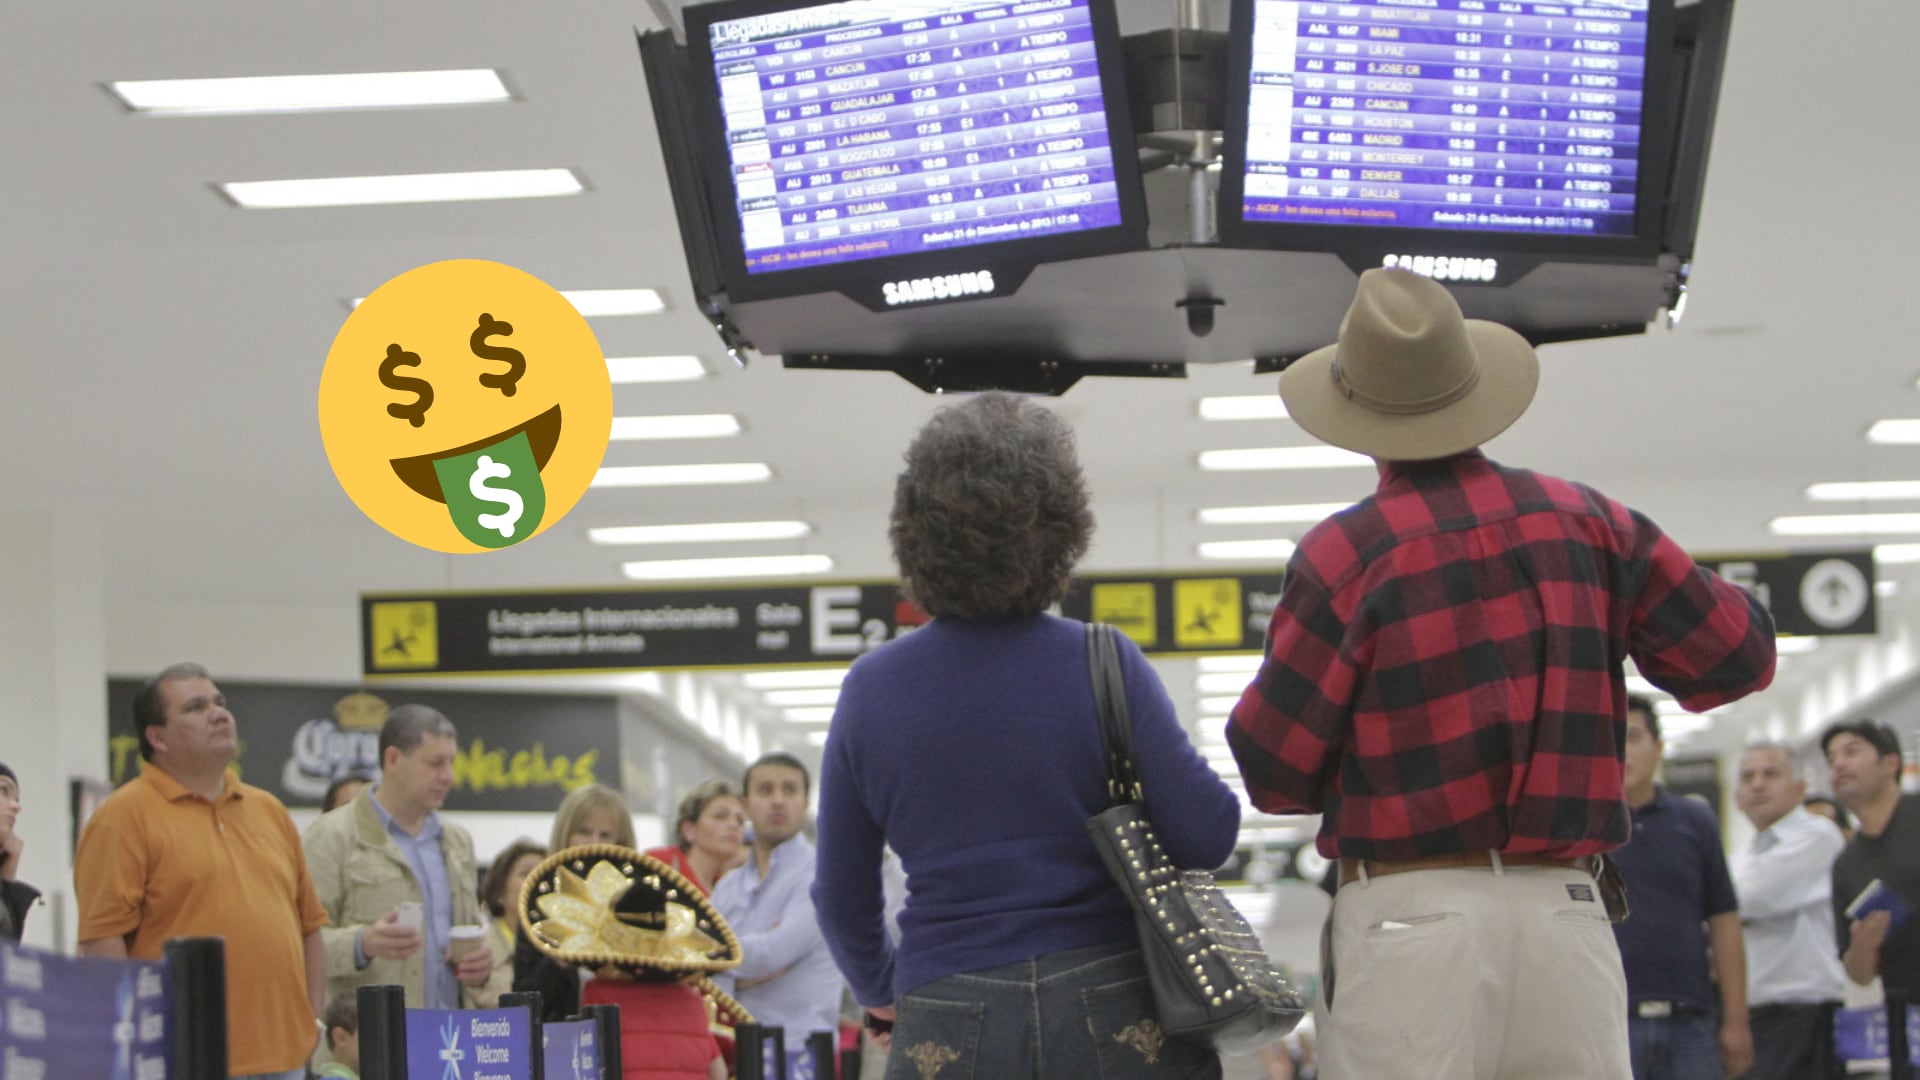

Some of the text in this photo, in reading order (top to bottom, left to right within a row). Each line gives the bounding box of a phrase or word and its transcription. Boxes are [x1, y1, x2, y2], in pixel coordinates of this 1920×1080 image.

[821, 44, 862, 58] CANCUN
[1368, 45, 1382, 55] LA
[1382, 46, 1404, 56] PAZ
[824, 61, 866, 76] CANCUN
[1366, 81, 1412, 92] CHICAGO
[830, 93, 895, 112] GUADALAJAR
[1364, 98, 1408, 110] CANCUN
[1363, 117, 1413, 128] HOUSTON
[835, 135, 850, 147] LA
[849, 129, 892, 145] HABANA
[1362, 133, 1403, 145] MADRID
[1361, 151, 1423, 165] MONTERREY
[841, 163, 900, 181] GUATEMALA
[1360, 169, 1402, 181] DENVER
[844, 186, 864, 198] LAS
[864, 181, 897, 196] VEGAS
[1359, 188, 1400, 199] DALLAS
[847, 200, 888, 215] TIJUANA
[883, 270, 995, 305] SAMSUNG
[488, 609, 581, 636] Llegadas
[583, 605, 739, 630] Internacionales
[755, 603, 802, 626] Sala
[488, 633, 583, 656] International
[585, 632, 646, 654] Arrivals
[471, 1017, 510, 1038] Bienvenido
[475, 1043, 510, 1064] Welcome
